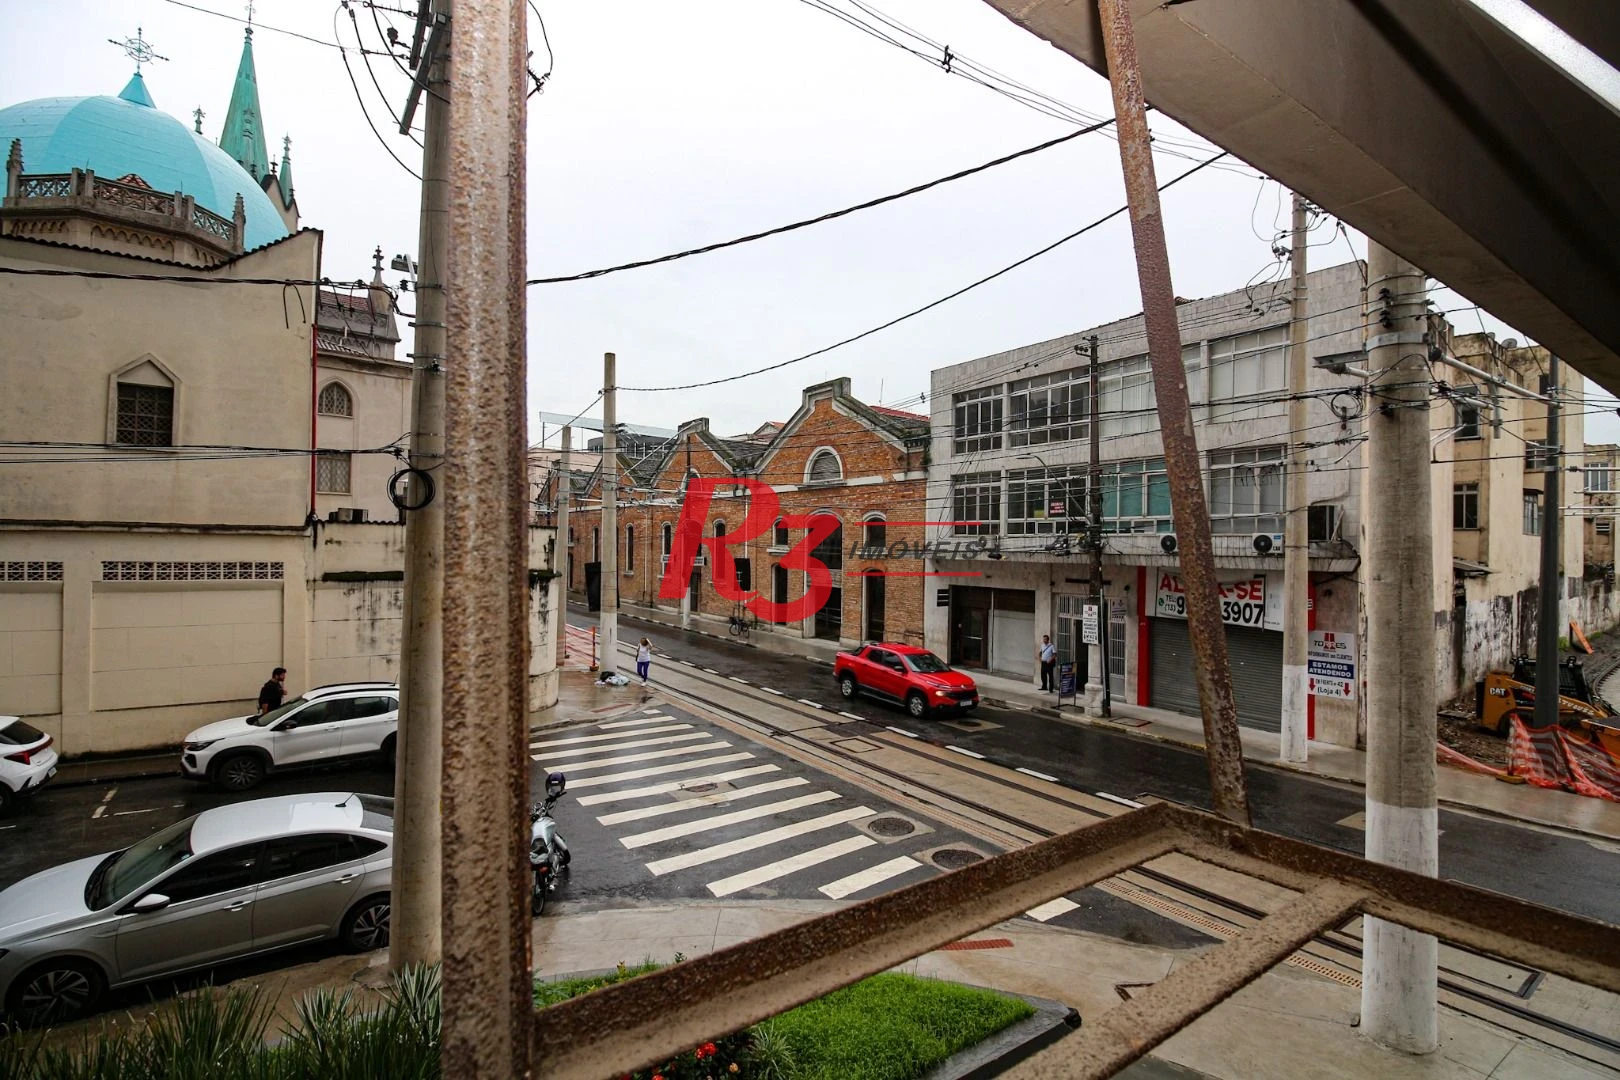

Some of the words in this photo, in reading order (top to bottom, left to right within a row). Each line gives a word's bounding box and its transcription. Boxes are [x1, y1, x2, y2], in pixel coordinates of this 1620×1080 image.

[1314, 640, 1347, 649] TORRES
[1312, 661, 1348, 670] ESTAMOS
[1309, 667, 1351, 677] ATENDENDO
[1317, 686, 1333, 695] (Loja
